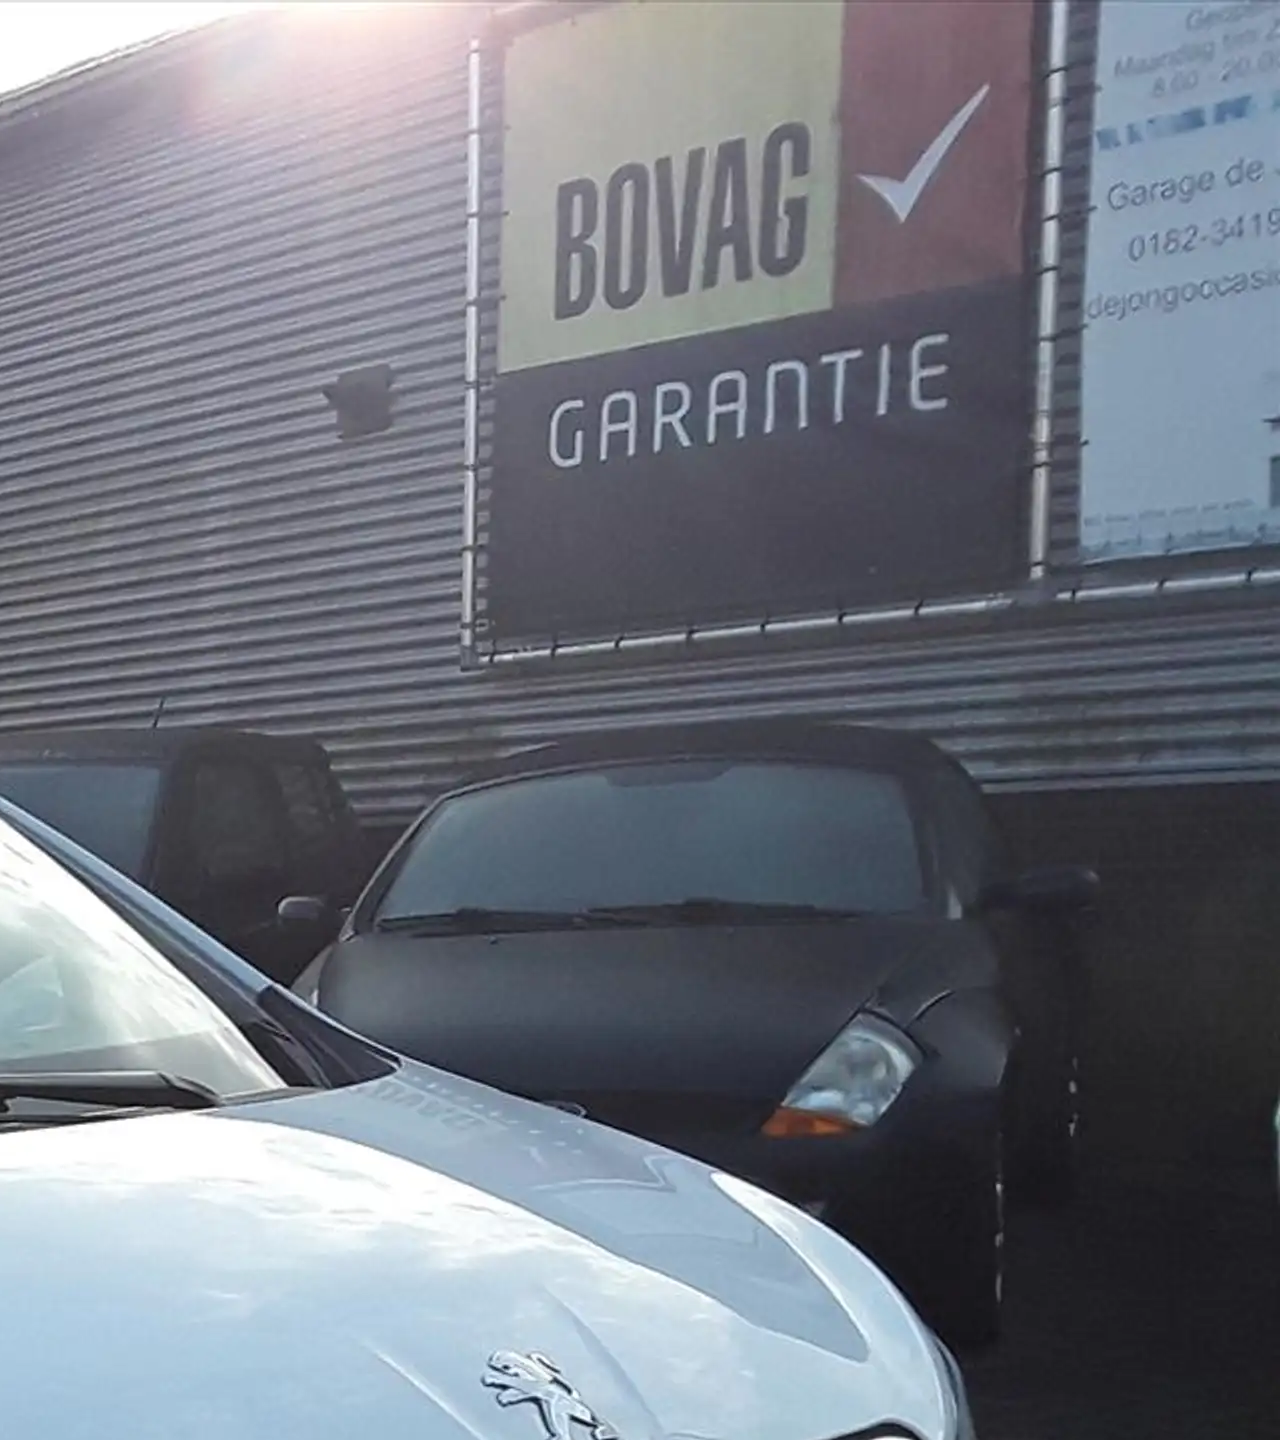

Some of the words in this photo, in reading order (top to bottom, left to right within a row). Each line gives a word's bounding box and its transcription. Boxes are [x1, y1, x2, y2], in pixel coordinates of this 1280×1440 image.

[553, 121, 810, 320] BOVAG
[1107, 170, 1215, 211] Garage
[1224, 156, 1265, 188] de
[547, 333, 949, 468] GARANTIE
